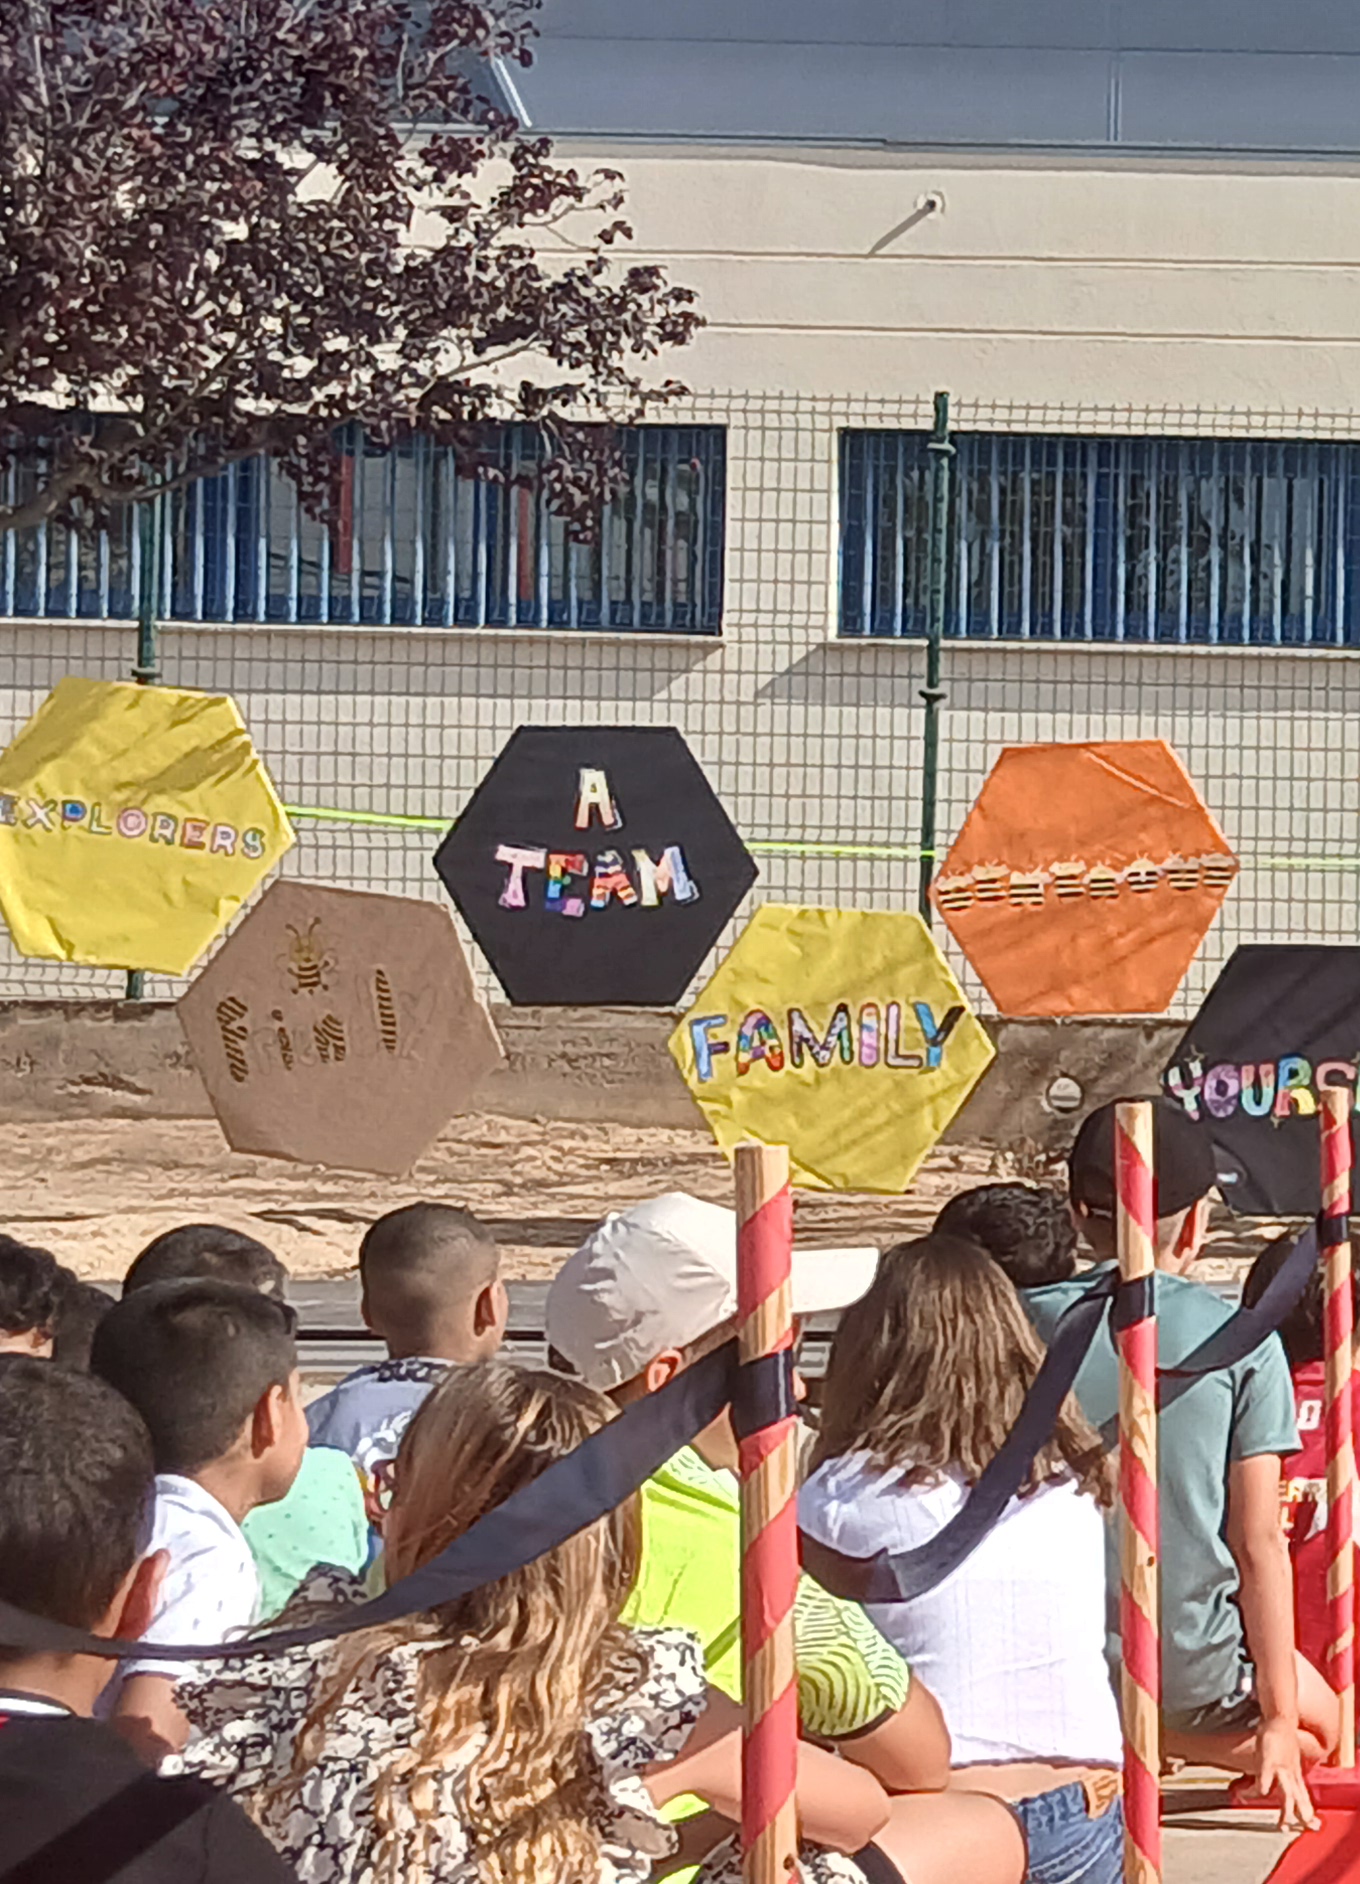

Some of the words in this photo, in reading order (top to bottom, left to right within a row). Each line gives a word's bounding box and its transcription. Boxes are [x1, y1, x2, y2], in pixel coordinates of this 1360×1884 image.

[0, 794, 266, 860] EXPLORERS
[573, 767, 623, 831] A
[494, 843, 699, 917] TEAM
[688, 1001, 966, 1083] FAMILY
